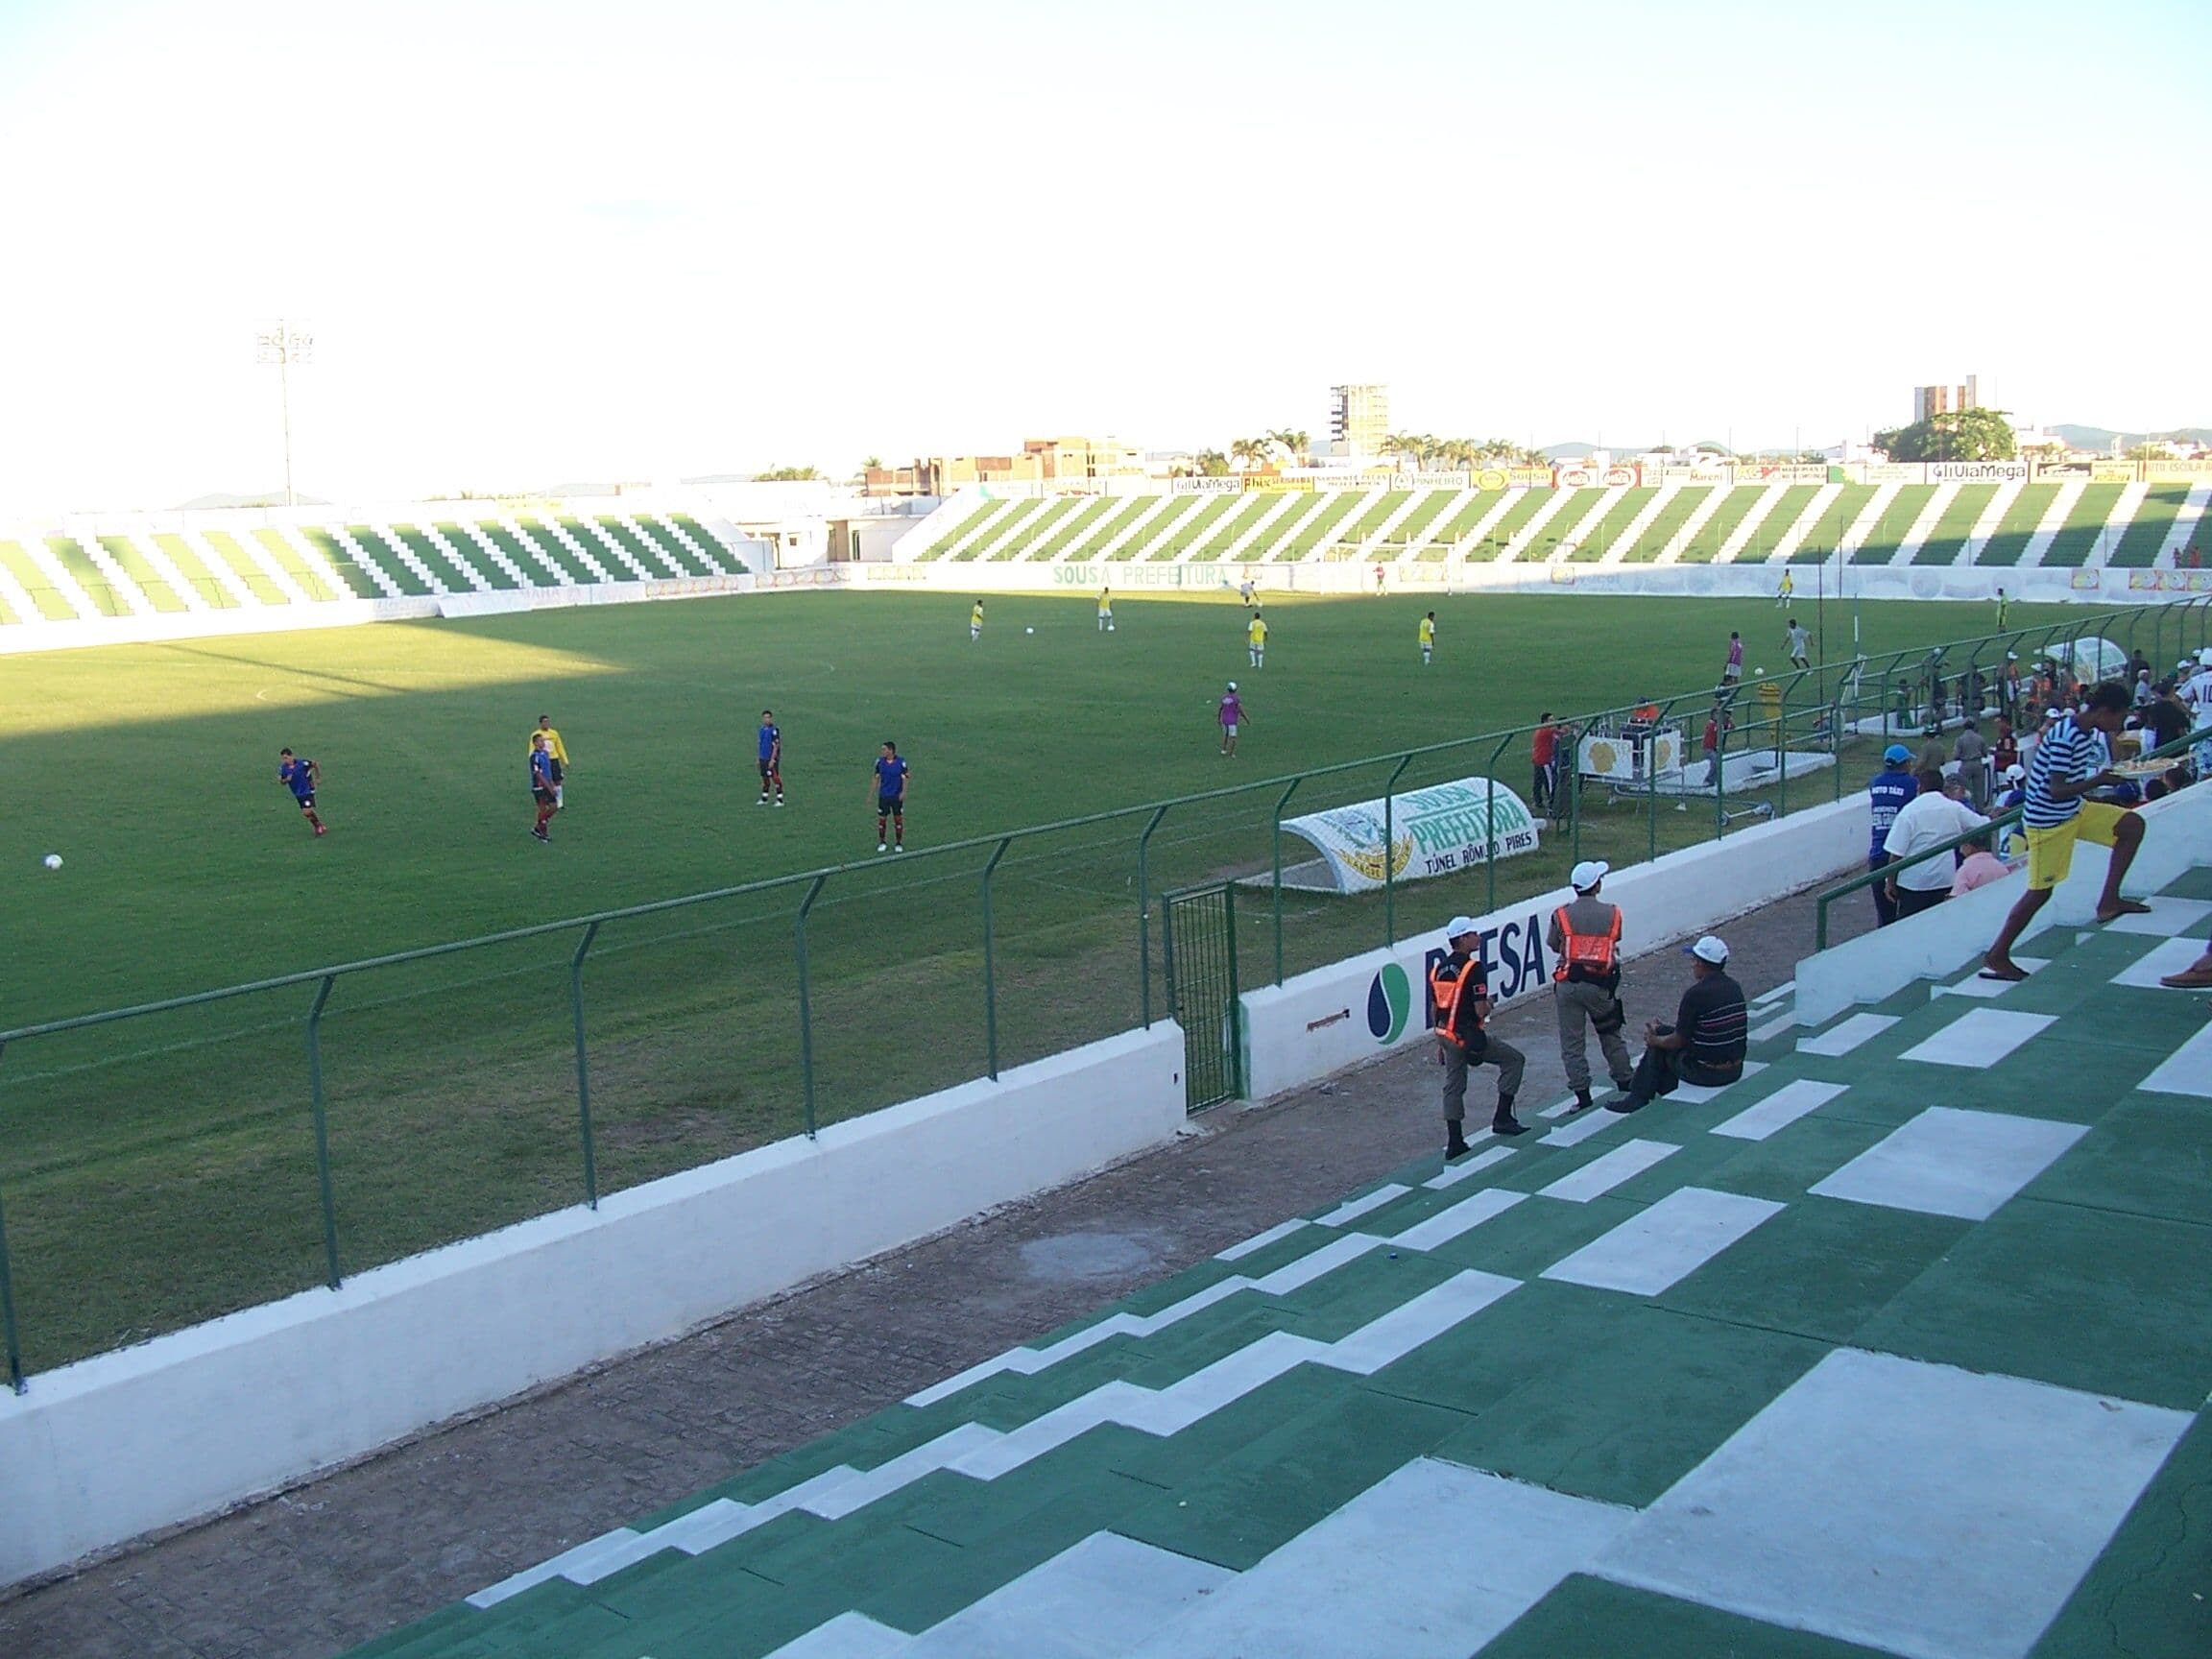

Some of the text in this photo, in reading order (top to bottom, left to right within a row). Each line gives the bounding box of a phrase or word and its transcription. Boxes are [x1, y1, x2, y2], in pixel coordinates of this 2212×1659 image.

[1053, 565, 1111, 585] SOUSA
[1425, 853, 1456, 875] TÚNEL
[1505, 830, 1533, 852] PIRES
